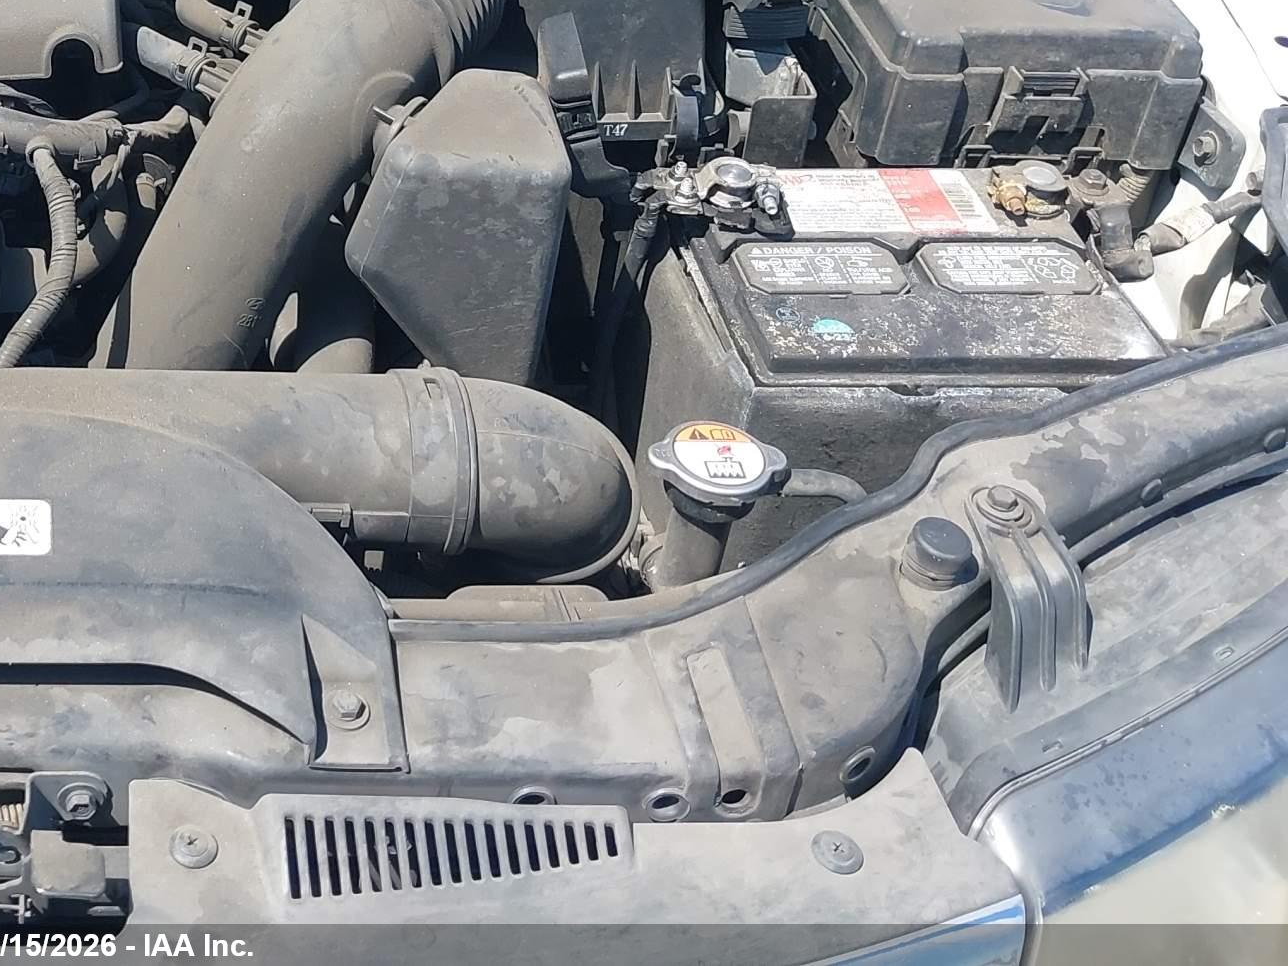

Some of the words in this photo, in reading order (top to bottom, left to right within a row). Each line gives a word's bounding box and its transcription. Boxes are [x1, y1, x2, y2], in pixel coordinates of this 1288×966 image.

[603, 123, 628, 137] T47
[764, 246, 813, 255] DANGER
[826, 246, 872, 254] POISON
